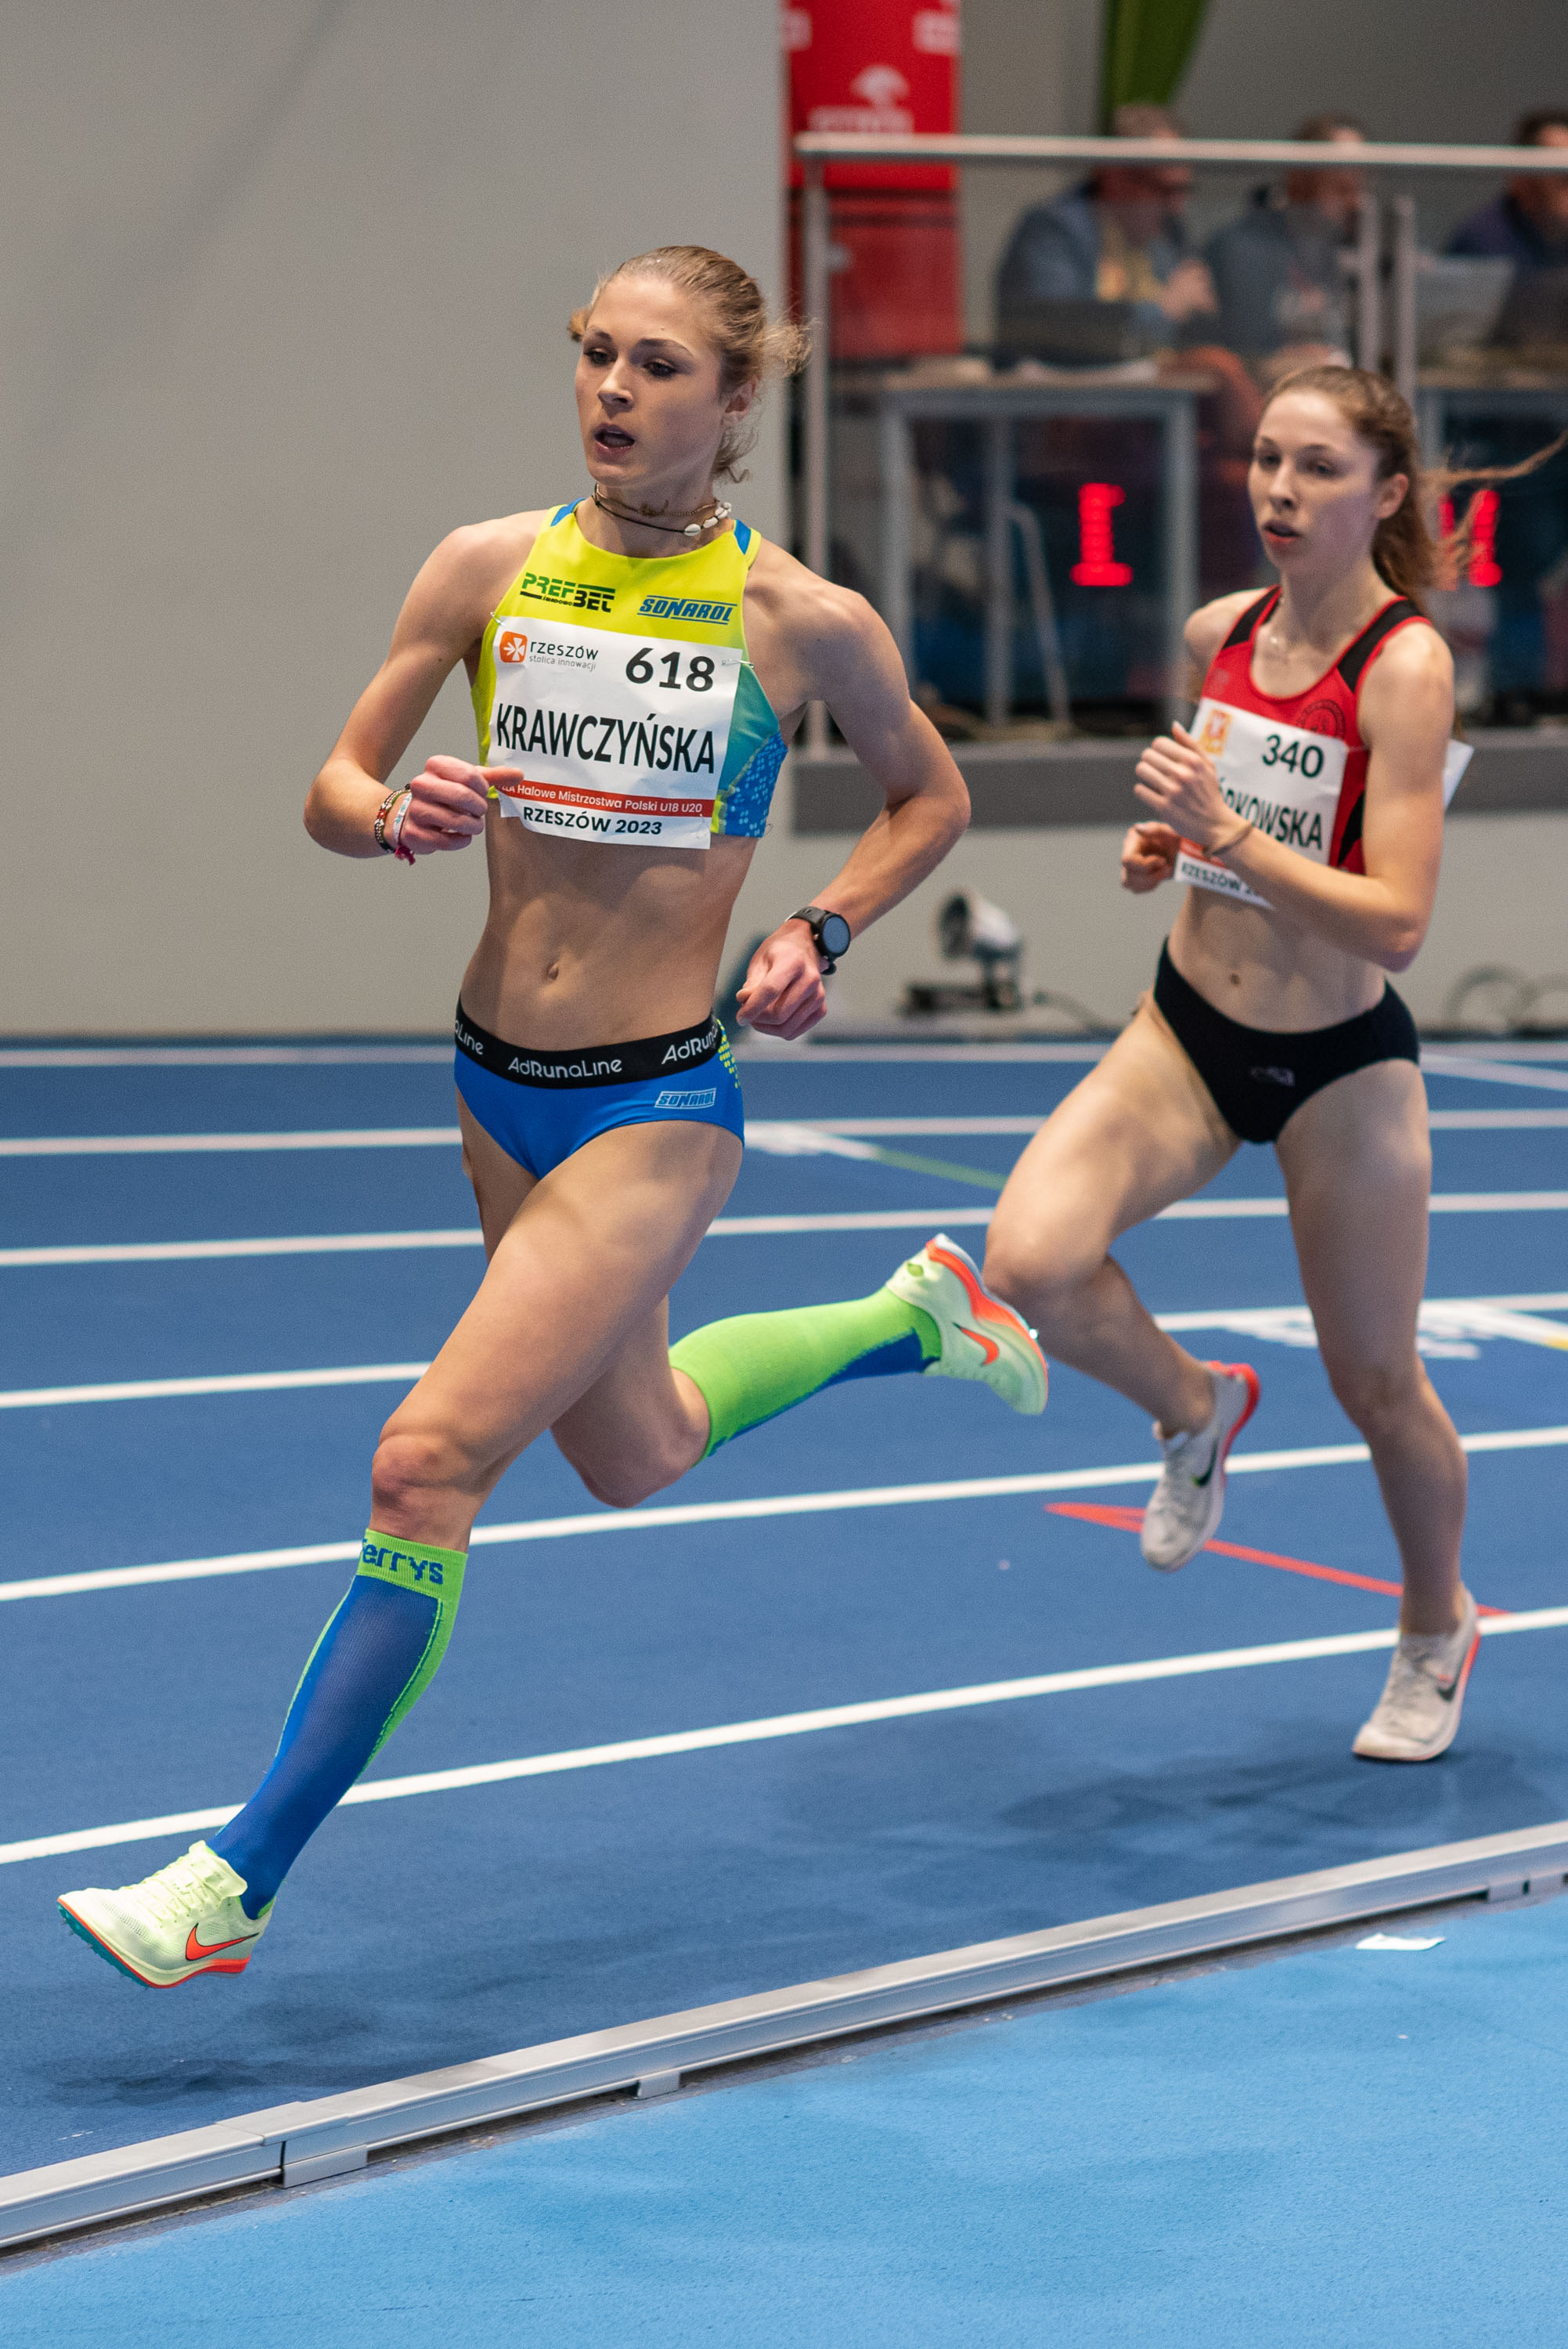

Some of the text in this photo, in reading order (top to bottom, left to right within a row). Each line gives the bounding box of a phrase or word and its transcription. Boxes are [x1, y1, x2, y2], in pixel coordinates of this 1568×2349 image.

[639, 597, 734, 622] SONAROL
[529, 655, 596, 673] stolica innowacji
[530, 641, 599, 661] rzeszów
[626, 648, 715, 692] 618
[496, 703, 715, 774] KRAWCZYŃSKA
[1262, 734, 1325, 778] 340
[517, 784, 556, 799] Halowe
[558, 790, 622, 808] Mistrzostwa
[625, 799, 658, 811] Polski
[660, 803, 679, 813] U18
[681, 803, 703, 814] U20
[523, 806, 662, 835] RZESZÓW 2023
[507, 1056, 623, 1079] AdRunaLine
